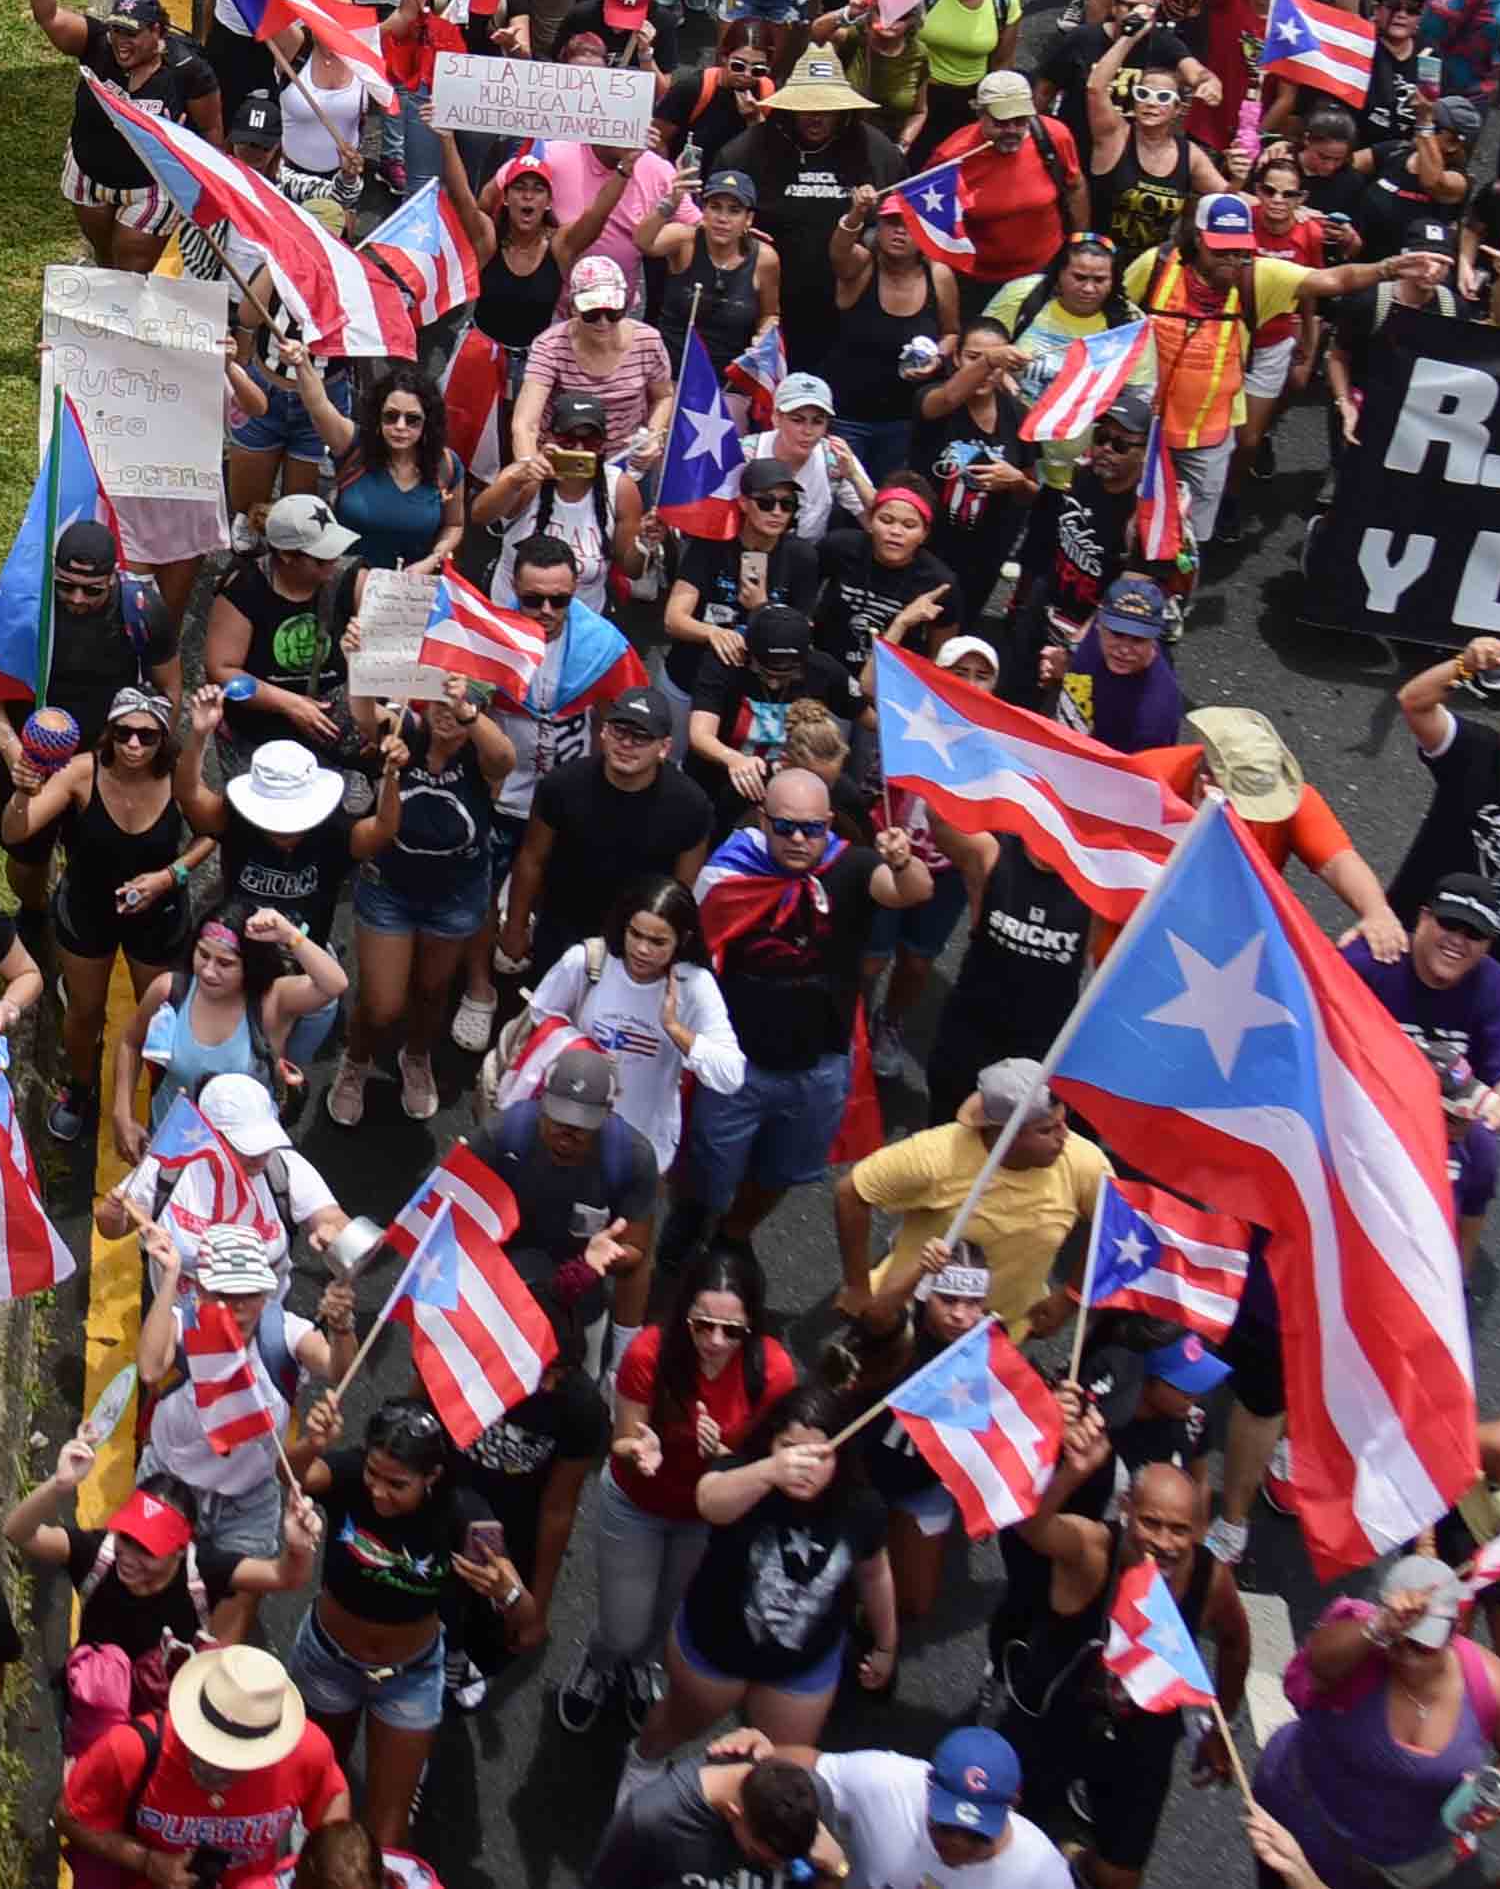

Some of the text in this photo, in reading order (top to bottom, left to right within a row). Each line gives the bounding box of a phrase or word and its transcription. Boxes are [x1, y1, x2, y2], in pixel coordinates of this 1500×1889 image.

[443, 56, 637, 99] SI LA DEUDA ES
[445, 105, 553, 132] AUDITORIA
[480, 82, 606, 118] PUBLICA LA
[52, 342, 181, 403] Puerto
[1358, 526, 1436, 613] Y
